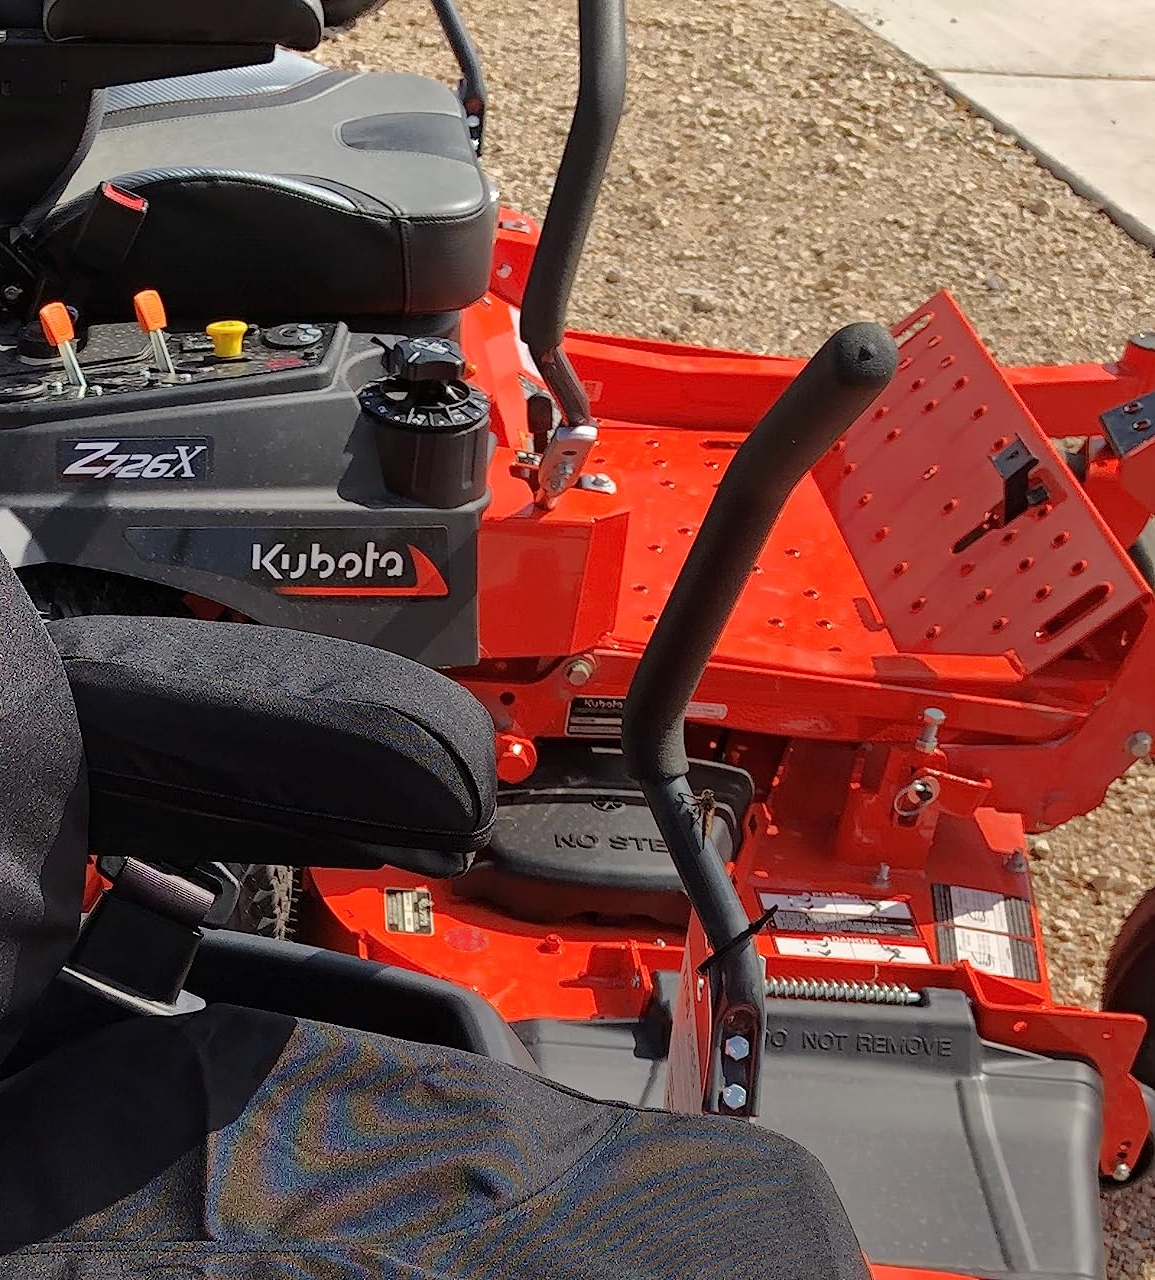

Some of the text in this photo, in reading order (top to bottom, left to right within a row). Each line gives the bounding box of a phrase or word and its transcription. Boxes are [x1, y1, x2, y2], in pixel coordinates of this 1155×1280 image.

[62, 441, 208, 480] Z726X
[252, 541, 404, 580] Kubota
[584, 699, 623, 709] Kubota
[554, 833, 669, 853] NO STE
[802, 1030, 848, 1050] NOT
[857, 1033, 952, 1057] REMOVE
